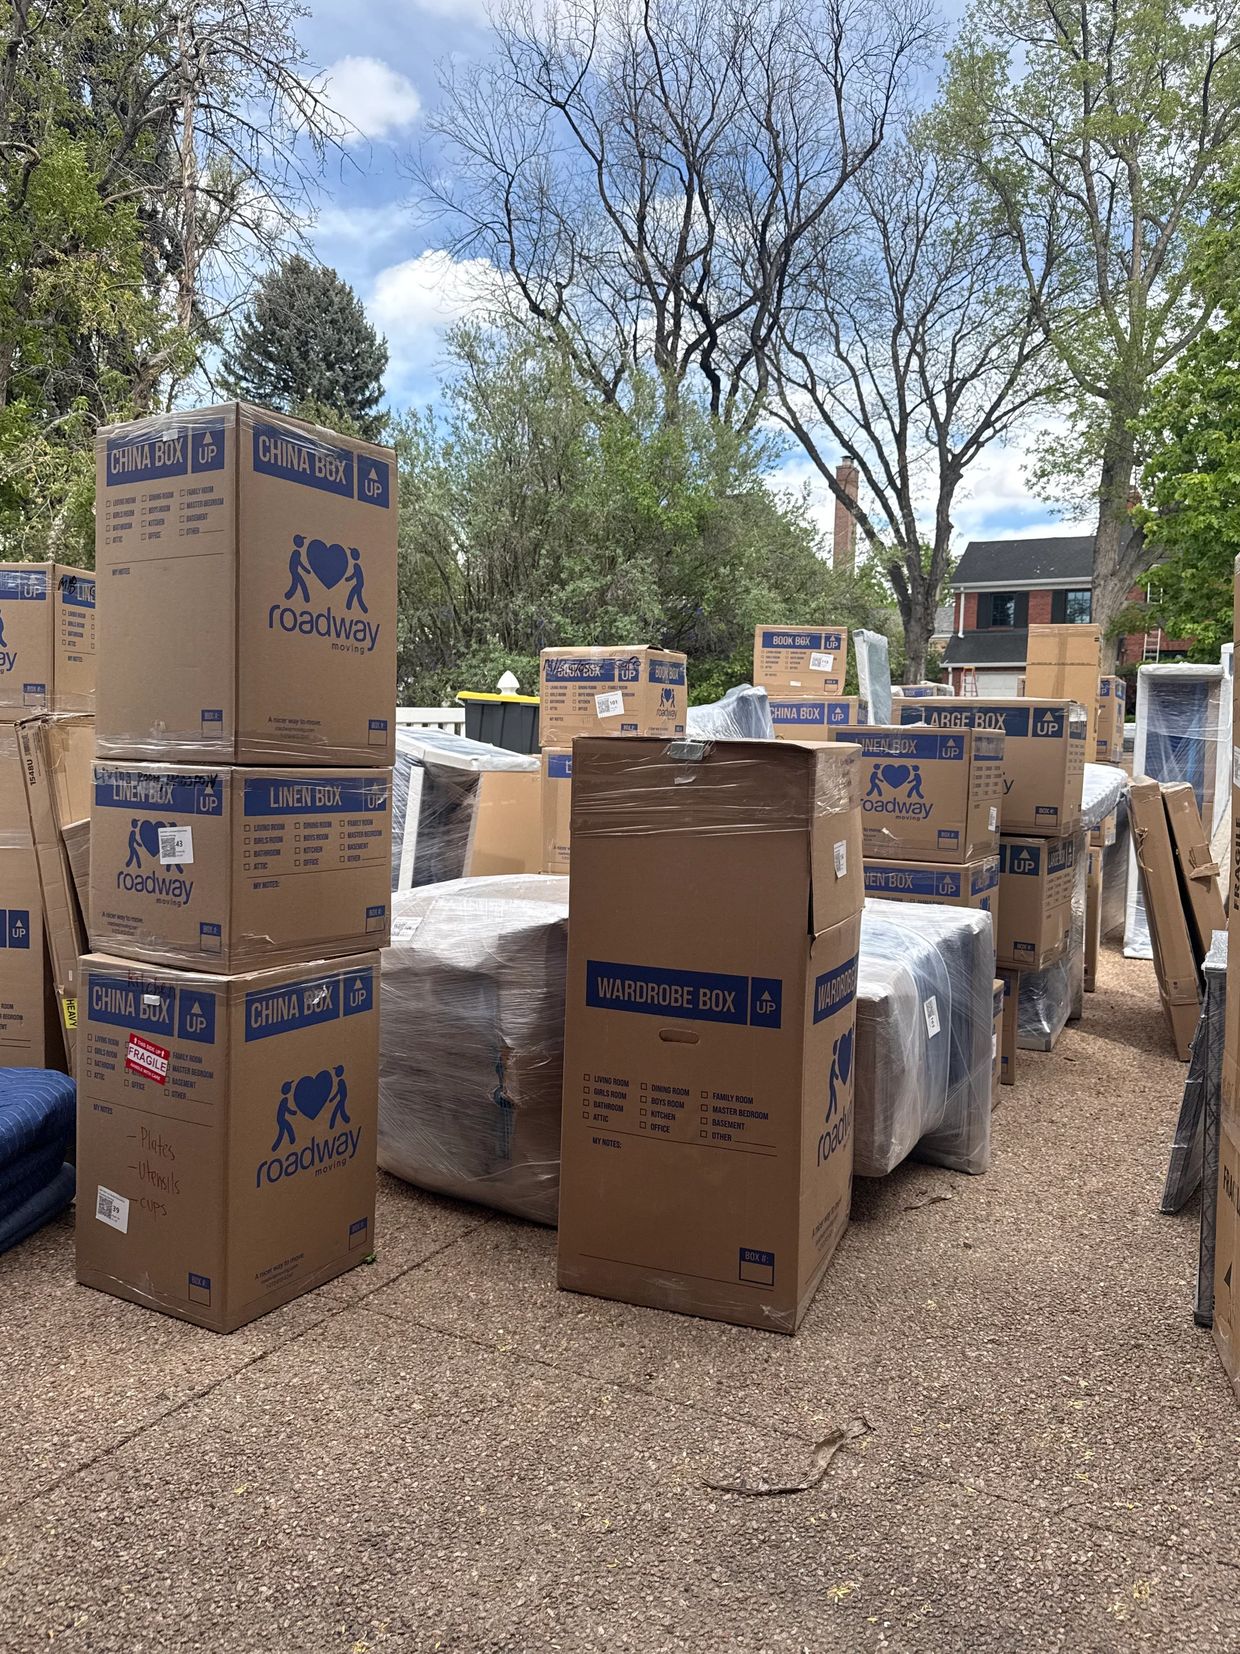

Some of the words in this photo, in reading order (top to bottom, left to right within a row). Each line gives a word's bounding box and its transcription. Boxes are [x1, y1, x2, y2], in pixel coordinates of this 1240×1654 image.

[110, 444, 151, 474] CHINA
[155, 438, 184, 467] BOX
[199, 445, 217, 464] UP
[258, 435, 310, 474] CHINA
[315, 454, 346, 485] BOX
[364, 479, 383, 498] UP
[268, 604, 381, 652] roadway
[772, 635, 794, 645] BOOK
[795, 636, 811, 646] BOX
[826, 641, 839, 649] UP
[331, 642, 365, 655] moving
[621, 670, 636, 680] UP
[769, 707, 798, 719] CHINA
[800, 707, 820, 720] BOX
[831, 713, 845, 721] UP
[974, 712, 1007, 730] BOX
[1036, 722, 1059, 736] UP
[892, 739, 918, 754] BOX
[942, 747, 959, 758] UP
[113, 780, 145, 802] LINEN
[149, 782, 174, 804] BOX
[270, 785, 311, 808] LINEN
[315, 786, 342, 807] BOX
[199, 796, 218, 812] UP
[367, 794, 384, 809] UP
[860, 797, 934, 819] oadway
[896, 814, 921, 822] moving
[1014, 860, 1035, 873] UP
[117, 870, 194, 905] roadway
[889, 873, 913, 889] BOX
[939, 883, 956, 894] UP
[156, 898, 182, 908] moving
[12, 928, 26, 938] UP
[350, 989, 367, 1007] UP
[597, 976, 694, 1008] WARDROBE
[698, 988, 736, 1013] BOX
[92, 985, 136, 1017] CHINA
[139, 994, 170, 1024] BOX
[250, 994, 299, 1029] CHINA
[303, 985, 333, 1016] BOX
[756, 1001, 776, 1014] UP
[66, 999, 77, 1027] HEAVY
[186, 1014, 207, 1033] UP
[128, 1046, 167, 1073] FRAGILE
[594, 1075, 612, 1085] LIVING
[612, 1078, 630, 1088] ROOM
[593, 1088, 610, 1098] GIRLS
[610, 1090, 627, 1100] ROOM
[651, 1084, 671, 1095] DINING
[671, 1087, 690, 1097] ROOM
[651, 1097, 666, 1107] BOYS
[666, 1099, 685, 1109] ROOM
[712, 1092, 734, 1103] FAMILY
[735, 1095, 754, 1105] ROOM
[593, 1100, 624, 1113] BATHROOM
[712, 1106, 737, 1117] MASTER
[738, 1109, 769, 1121] BEDROOM
[592, 1113, 609, 1123] ATTIC
[650, 1110, 676, 1121] KITCHEN
[650, 1123, 671, 1134] OFFICE
[711, 1118, 745, 1130] BASEMENT
[140, 1126, 176, 1161] Plates
[592, 1136, 603, 1146] MY
[604, 1138, 623, 1149] NOTES:
[711, 1132, 732, 1142] OTHER
[256, 1125, 362, 1189] roadway
[314, 1158, 348, 1177] moving
[138, 1160, 181, 1195] Utensils
[112, 1205, 120, 1214] 39
[140, 1197, 168, 1221] cups
[745, 1250, 760, 1262] BOX
